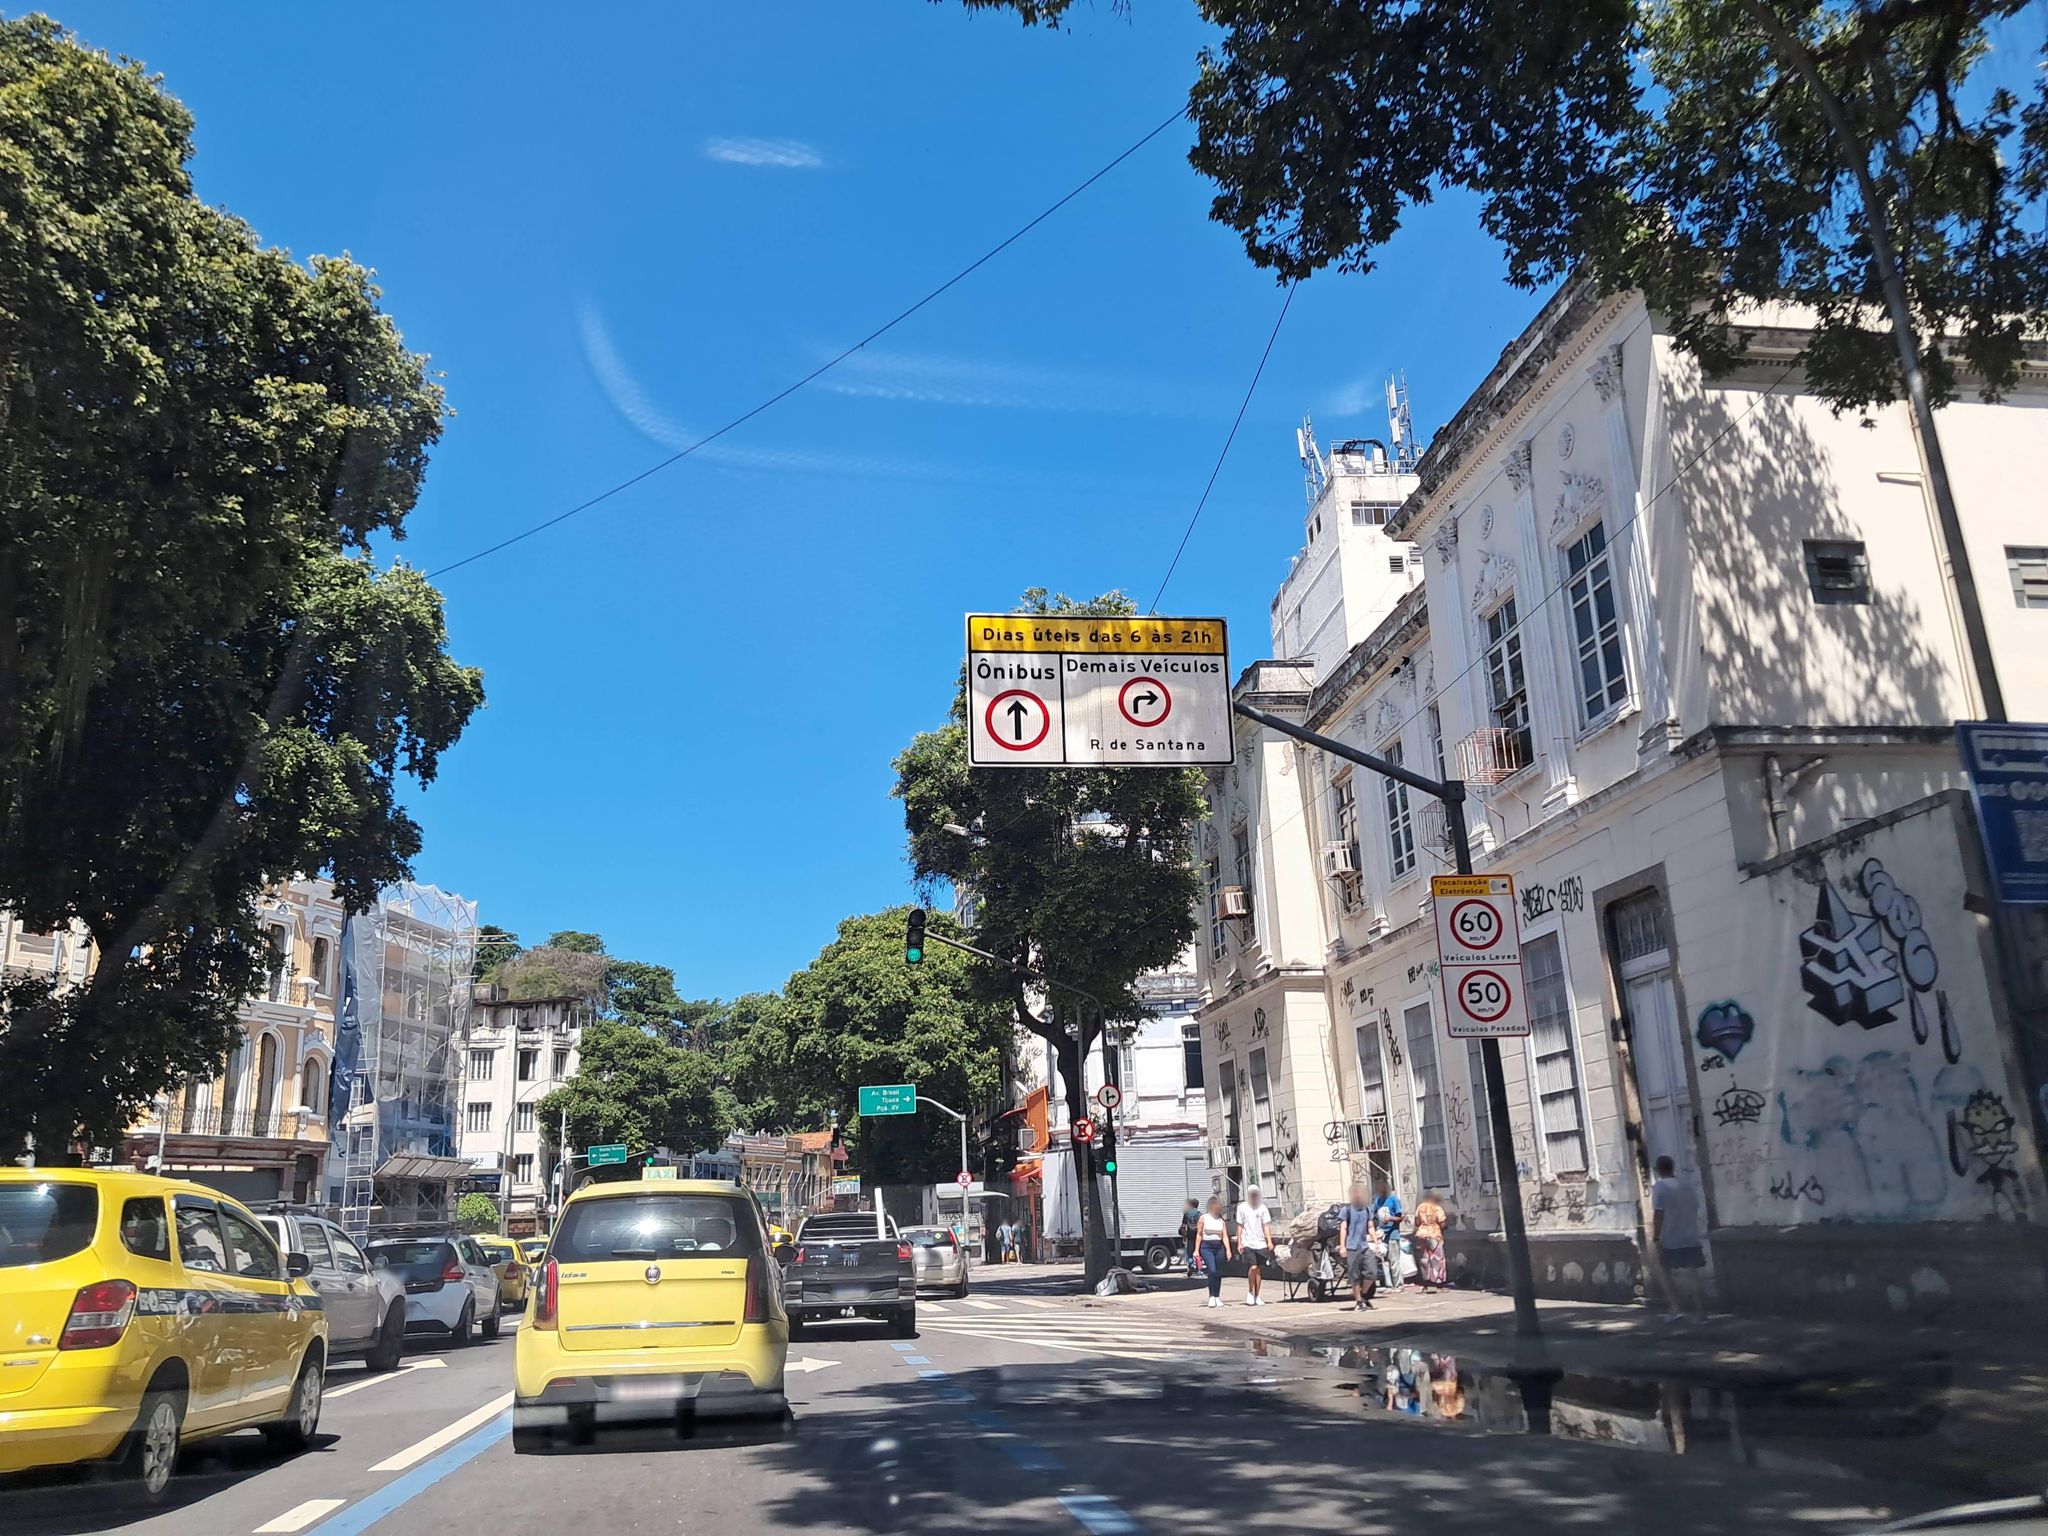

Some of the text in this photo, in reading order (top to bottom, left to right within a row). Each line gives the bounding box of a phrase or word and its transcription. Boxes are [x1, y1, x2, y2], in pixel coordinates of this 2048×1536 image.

[983, 627, 1212, 644] Dias úteis das 6 às 21h
[977, 658, 1056, 680] Ônibus
[1067, 658, 1220, 674] Demais Veículos
[1090, 739, 1205, 751] R. de Santana
[1459, 911, 1493, 933] 60
[1489, 953, 1517, 961] Leves
[1467, 982, 1501, 1004] 50
[647, 1168, 676, 1179] TAXI
